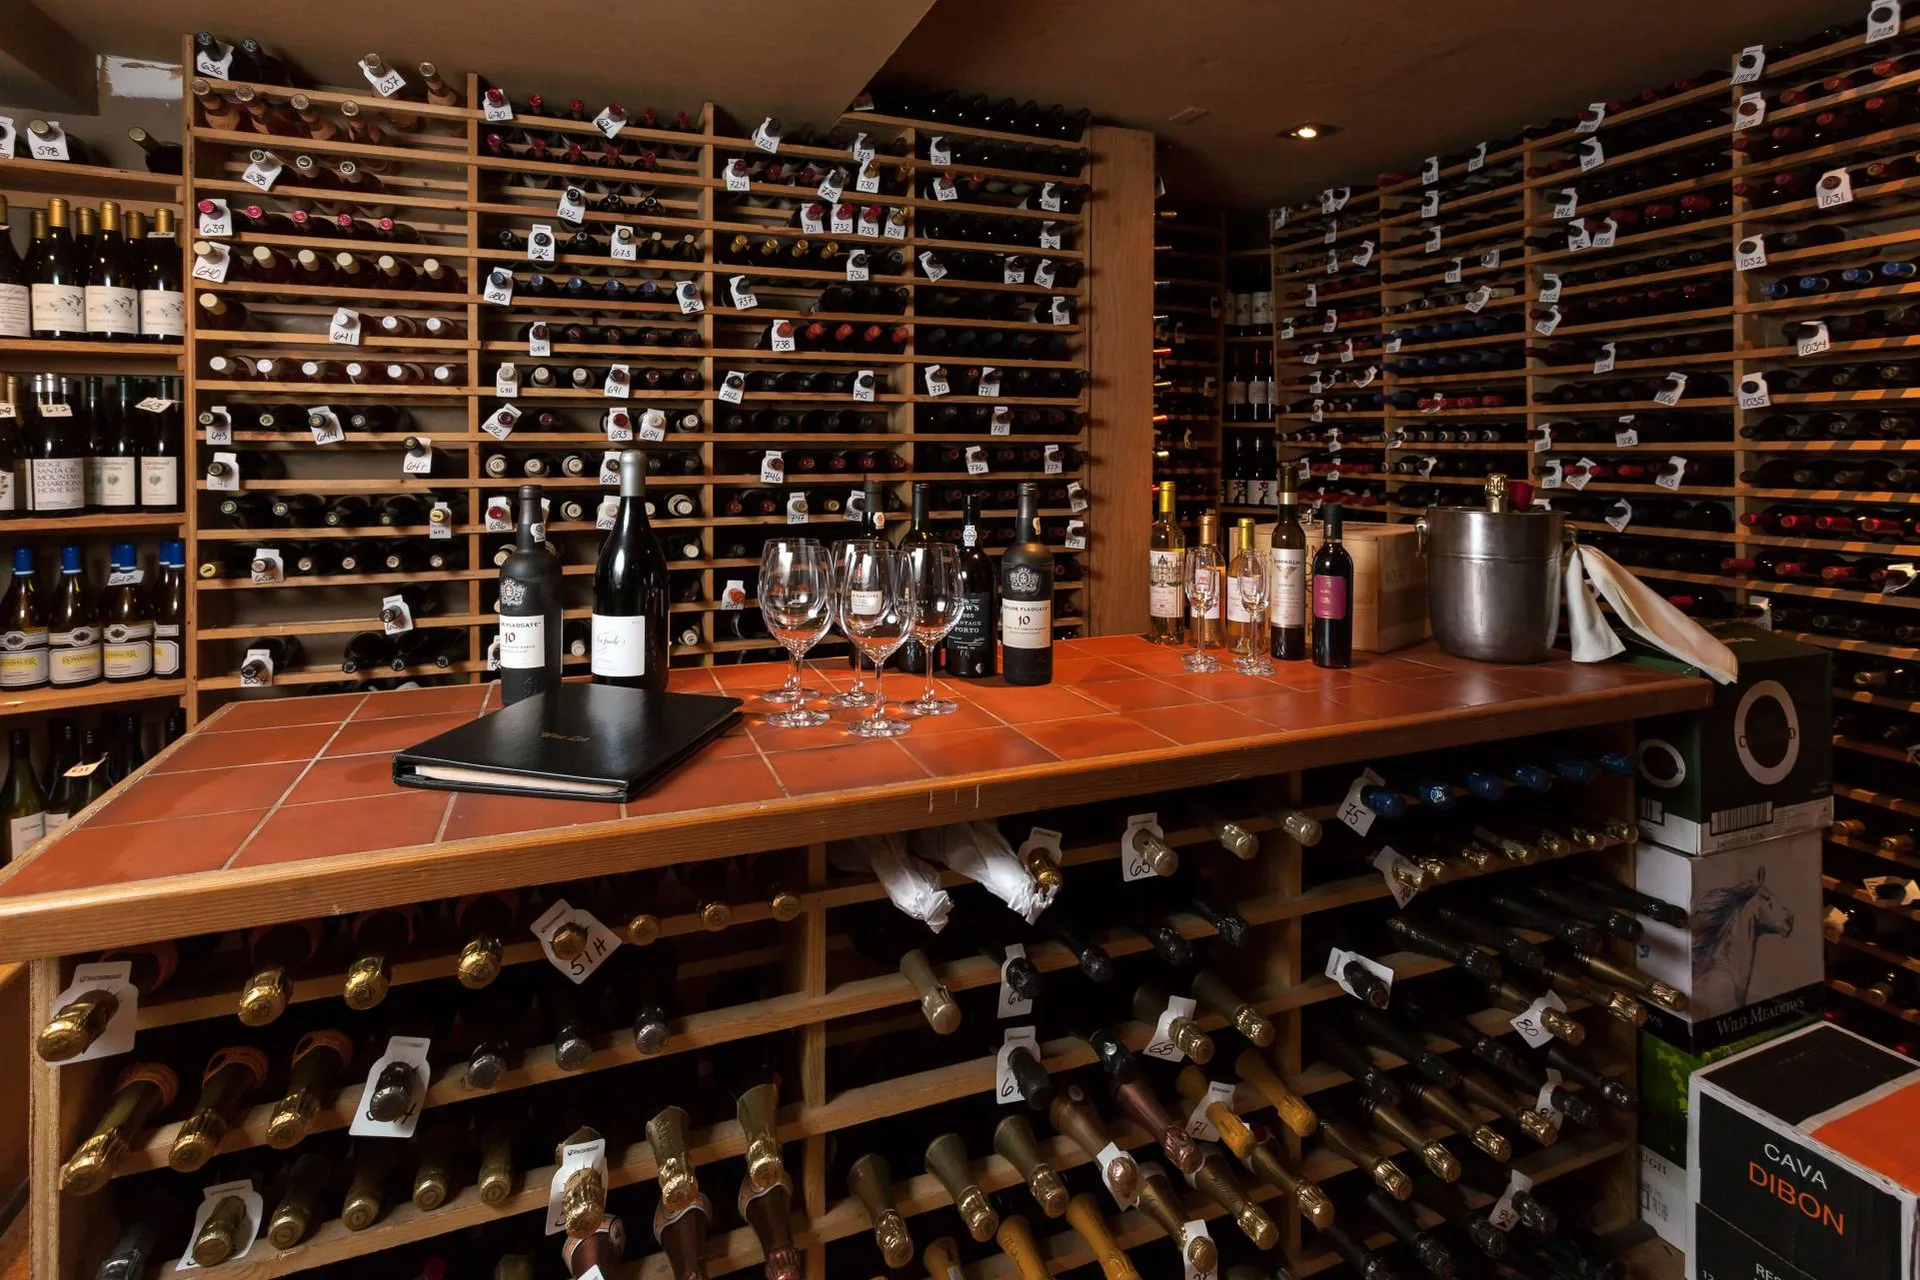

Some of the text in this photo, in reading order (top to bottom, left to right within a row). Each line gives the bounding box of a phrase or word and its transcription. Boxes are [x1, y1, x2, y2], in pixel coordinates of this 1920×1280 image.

[201, 62, 222, 75] 636
[380, 76, 399, 94] 637
[757, 137, 772, 149] 723
[37, 145, 59, 157] 598
[933, 155, 948, 164] 763
[245, 169, 267, 187] 638
[730, 180, 746, 189] 724
[861, 180, 874, 190] 730
[821, 186, 836, 199] 725
[1822, 192, 1844, 206] 1031
[559, 208, 576, 220] 672
[1555, 208, 1571, 217] 992
[203, 223, 225, 234] 639
[806, 223, 817, 232] 731
[834, 223, 850, 232] 732
[861, 226, 875, 236] 733
[887, 227, 900, 236] 734
[613, 248, 631, 257] 673
[1741, 256, 1765, 267] 1032
[196, 266, 221, 280] 640
[850, 270, 865, 279] 736
[487, 291, 507, 302] 680
[333, 331, 353, 342] 641
[774, 340, 790, 349] 738
[1801, 341, 1827, 354] 1034
[607, 386, 621, 395] 691
[722, 391, 737, 401] 742
[1743, 396, 1765, 406] 1035
[317, 430, 337, 442] 644
[611, 430, 627, 439] 693
[643, 429, 659, 439] 694
[602, 474, 618, 484] 695
[764, 471, 781, 482] 746
[490, 520, 507, 531] 696
[1018, 615, 1030, 626] 10
[505, 632, 516, 644] 10
[1344, 804, 1368, 826] 75
[1716, 996, 1806, 1037] WILD MEADOWS
[1515, 1017, 1539, 1037] 80
[1149, 1042, 1176, 1057] 68
[1188, 1120, 1208, 1136] 71
[1763, 1143, 1829, 1190] CAVA
[1749, 1161, 1845, 1236] DIBON
